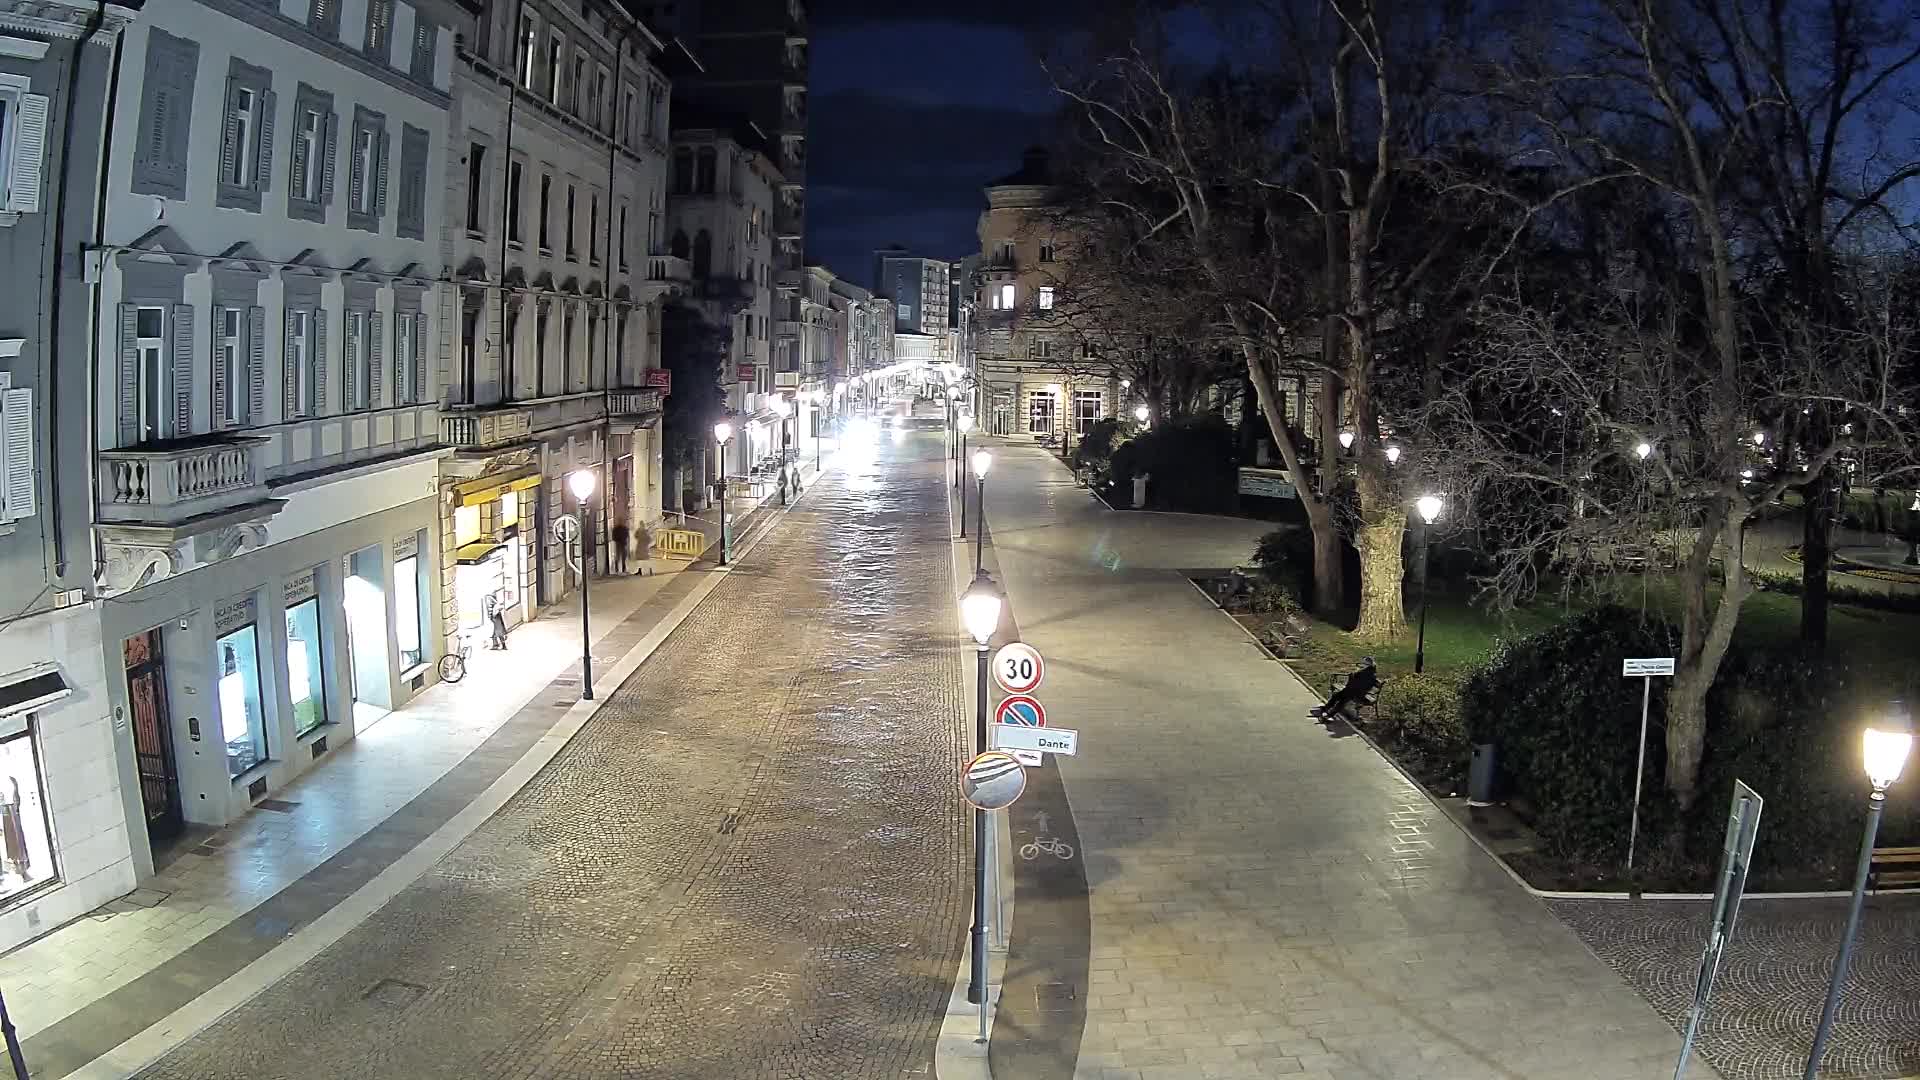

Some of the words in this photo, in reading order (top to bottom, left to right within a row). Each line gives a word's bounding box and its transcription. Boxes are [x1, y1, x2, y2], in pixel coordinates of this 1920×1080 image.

[215, 611, 245, 629] OPERATIVO
[1006, 659, 1032, 680] 30
[1038, 738, 1070, 749] Dante
